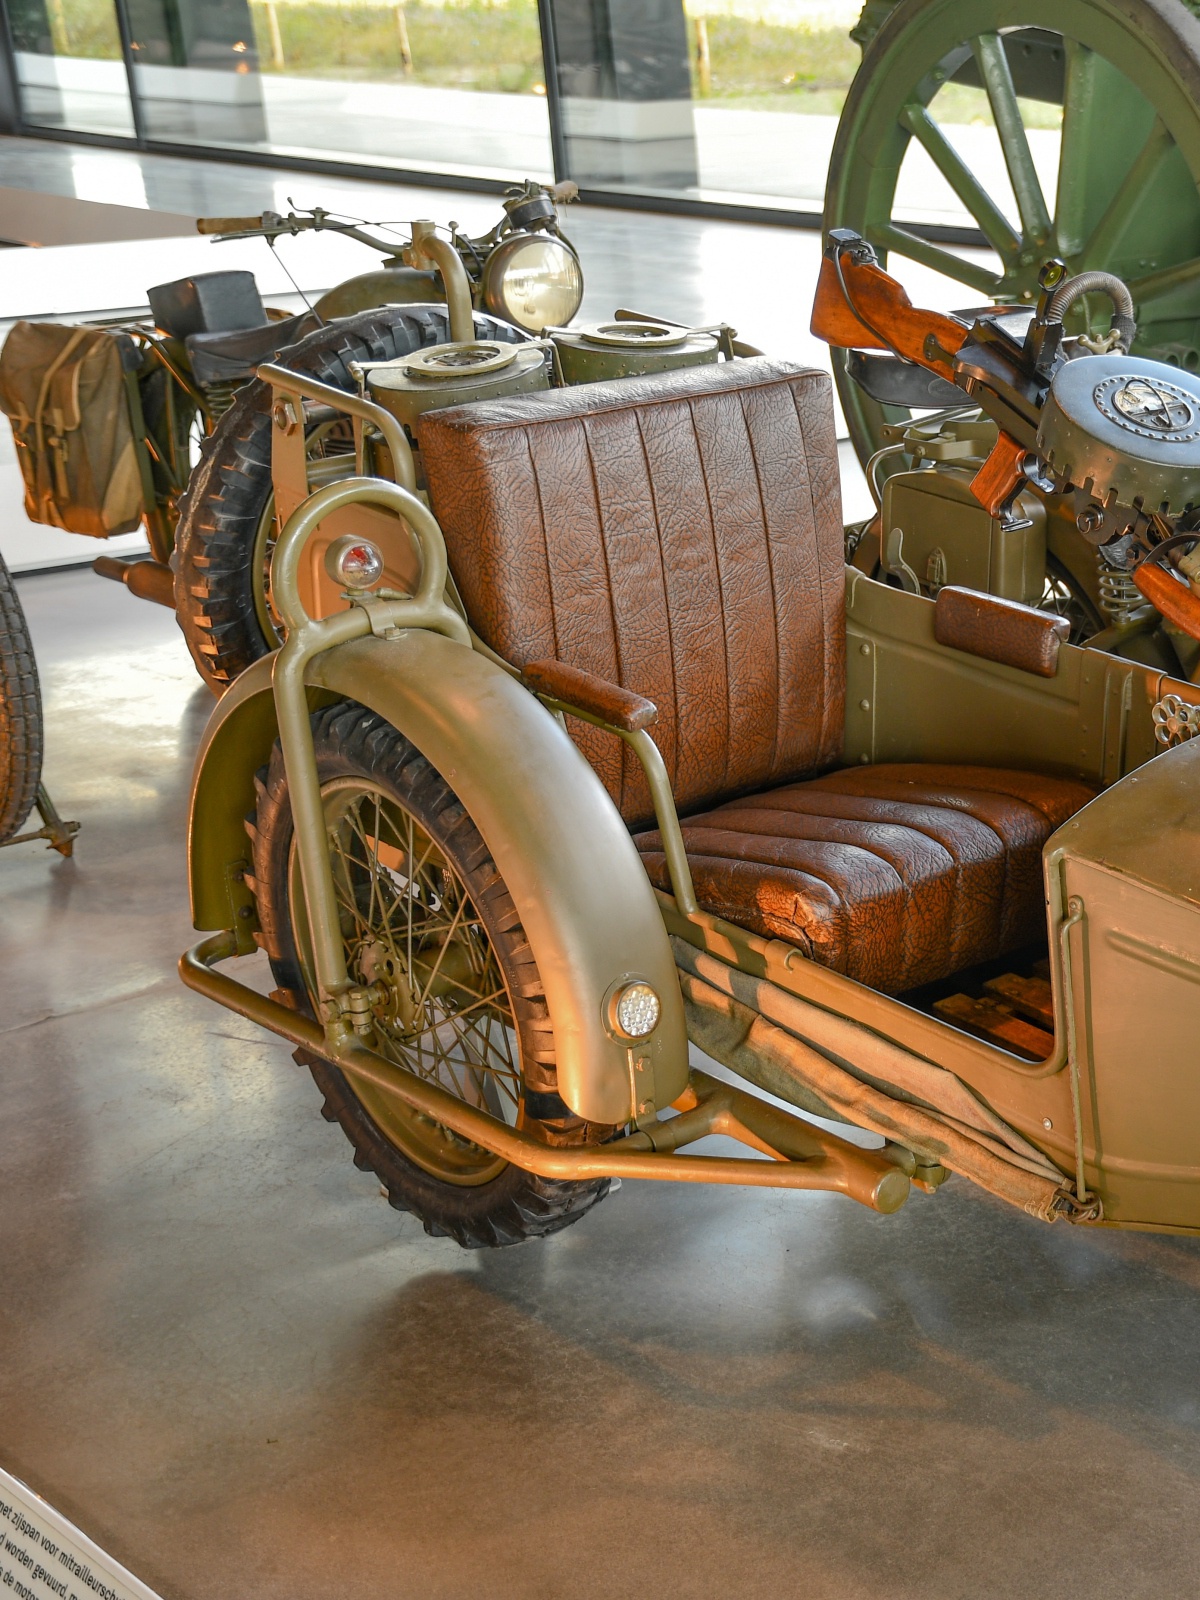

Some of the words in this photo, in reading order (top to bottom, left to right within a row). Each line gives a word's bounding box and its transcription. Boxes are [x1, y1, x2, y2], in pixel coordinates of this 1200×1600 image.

[11, 1512, 41, 1543] zijspan
[41, 1535, 60, 1557] voor
[3, 1569, 14, 1587] de
[5, 1539, 34, 1570] worden
[32, 1564, 69, 1600] gevuurd,
